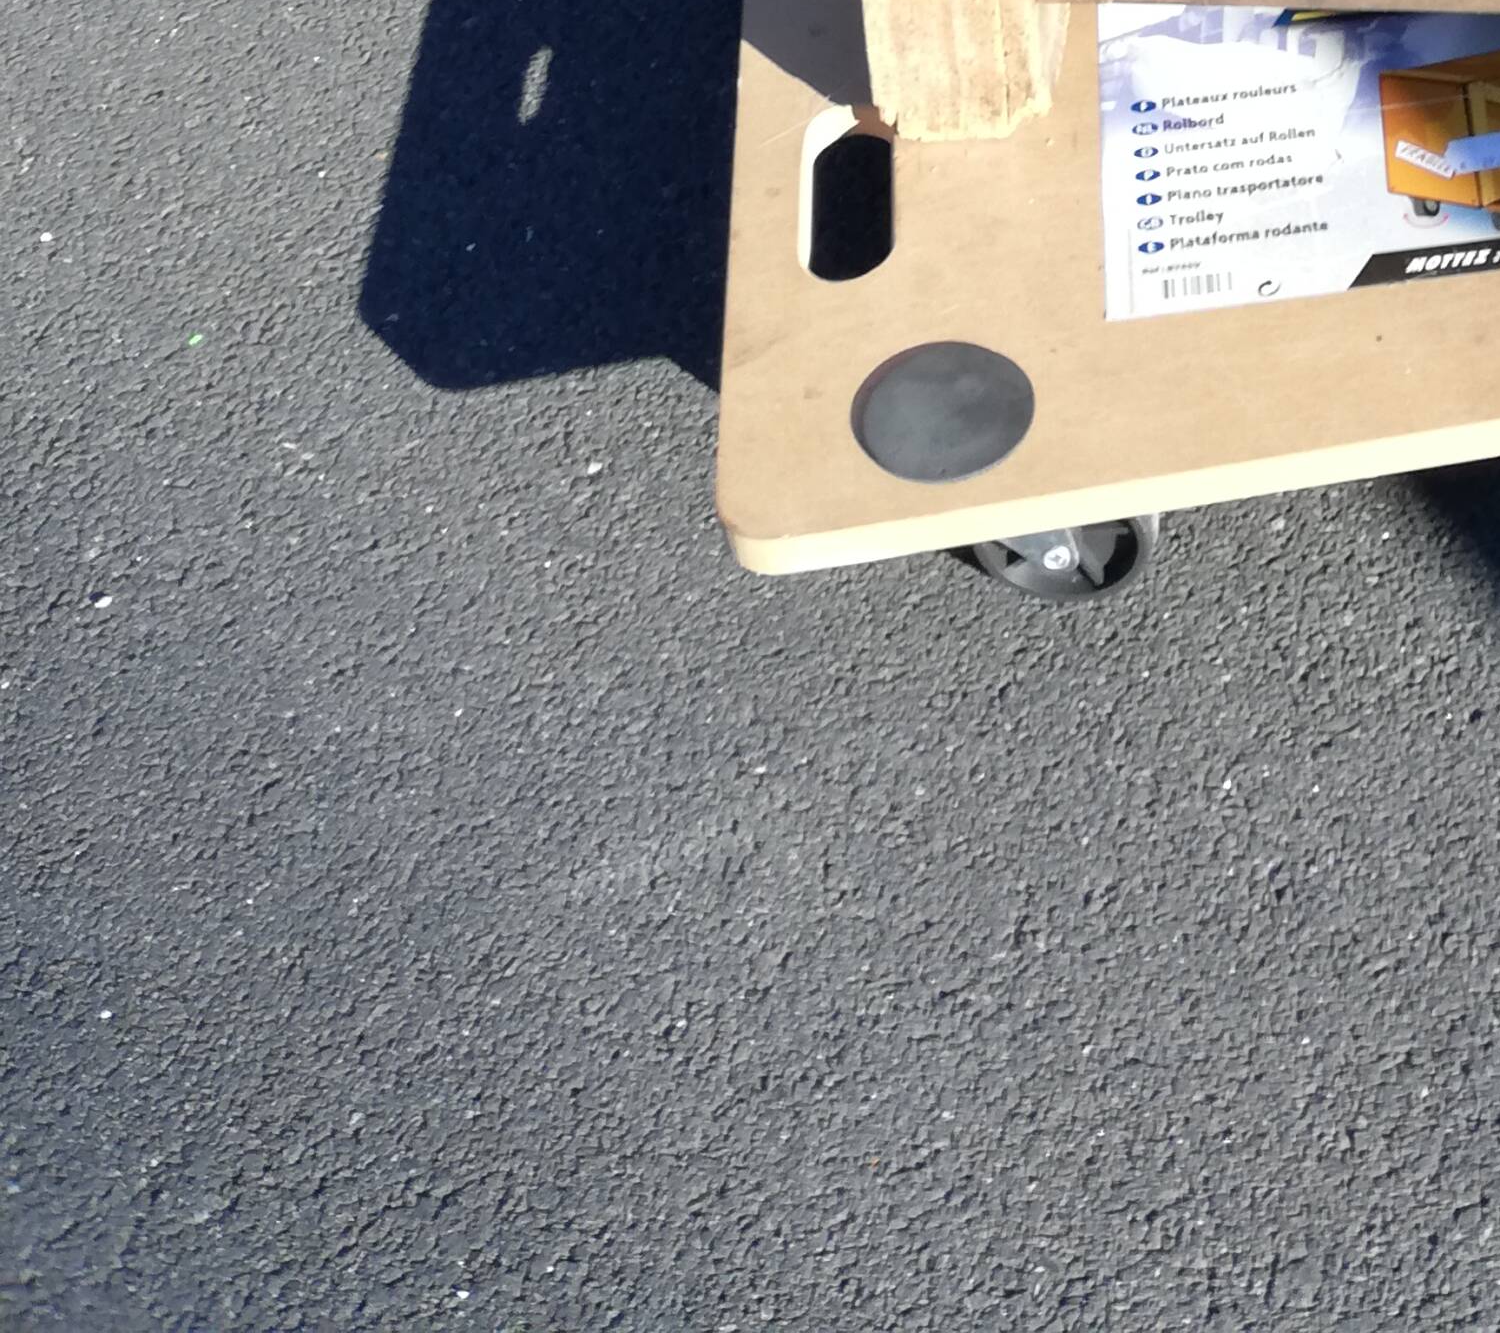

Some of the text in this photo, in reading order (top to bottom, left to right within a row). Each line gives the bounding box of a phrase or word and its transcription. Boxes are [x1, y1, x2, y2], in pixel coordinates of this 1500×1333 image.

[1161, 83, 1297, 110] Plateaux rouleurs
[1162, 113, 1225, 132] Rolbord
[1164, 127, 1316, 155] Untersatz auf Rollen
[1166, 154, 1293, 178] Prato com rodas
[1167, 173, 1324, 202] Piano trasportatore
[1169, 210, 1224, 226] Trolley
[1169, 221, 1329, 251] Plataforma rodante
